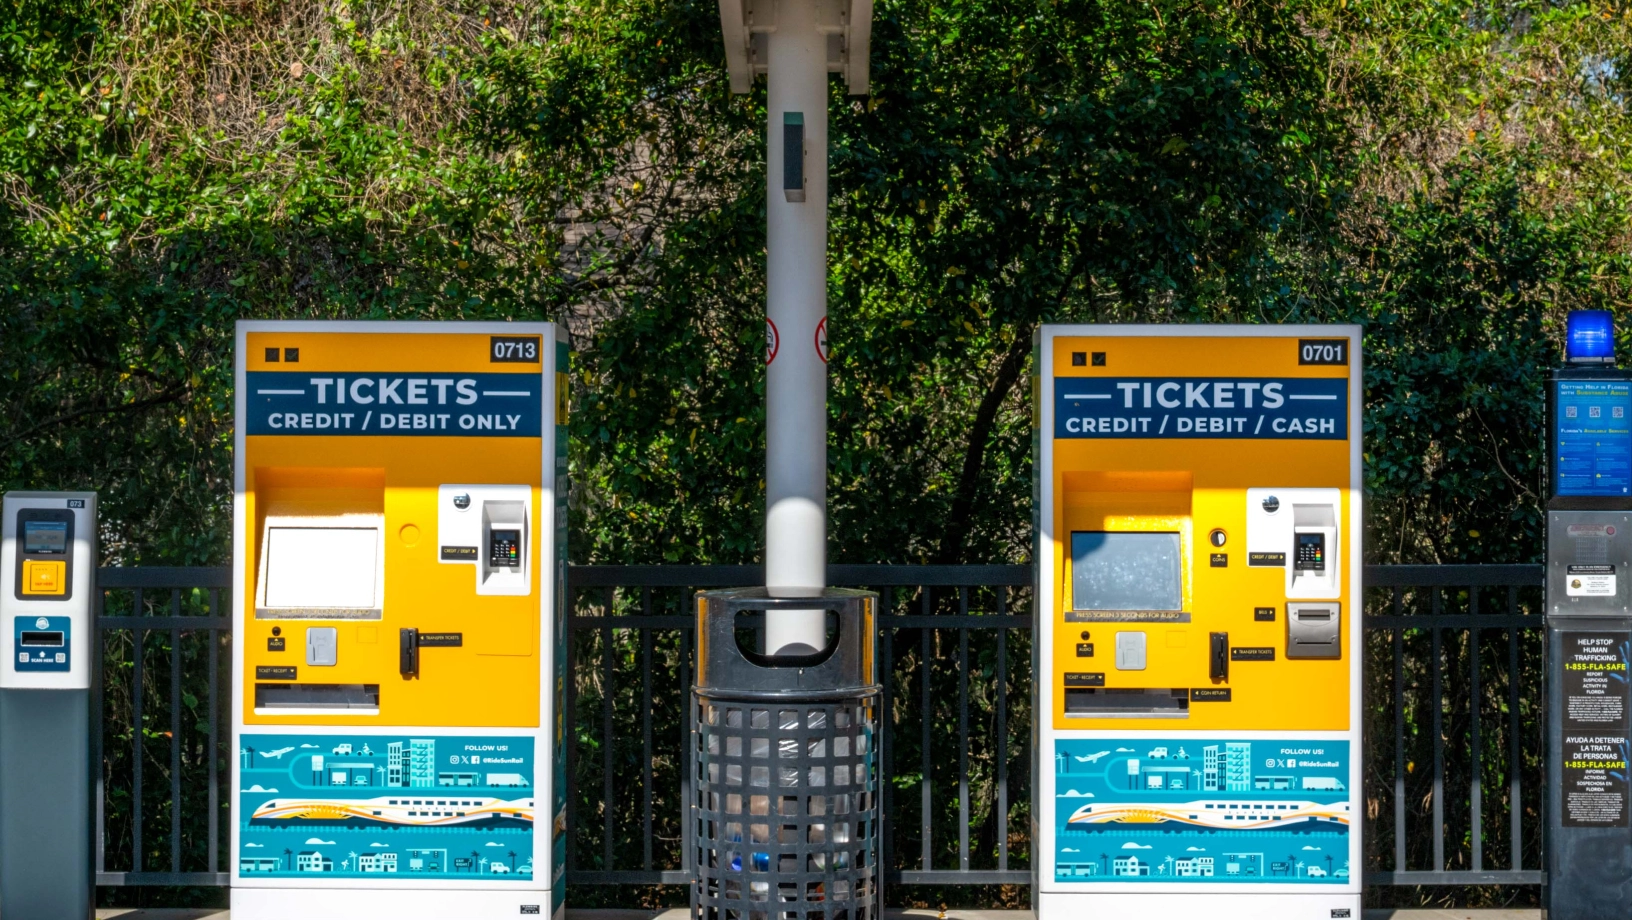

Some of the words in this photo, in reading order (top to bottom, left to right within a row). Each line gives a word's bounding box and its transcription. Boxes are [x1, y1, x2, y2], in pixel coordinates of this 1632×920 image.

[494, 342, 536, 359] 0713
[1302, 346, 1342, 361] 0701
[310, 378, 478, 405] TICKETS
[1116, 382, 1284, 408] TICKETS
[268, 413, 355, 428] CREDIT
[361, 411, 372, 430] /
[380, 414, 450, 429] DEBIT
[459, 414, 521, 430] ONLY
[1066, 417, 1151, 433] CREDIT
[1159, 415, 1169, 434] /
[1177, 417, 1247, 433] DEBIT
[1254, 415, 1264, 434] /
[1272, 418, 1334, 434] CASH
